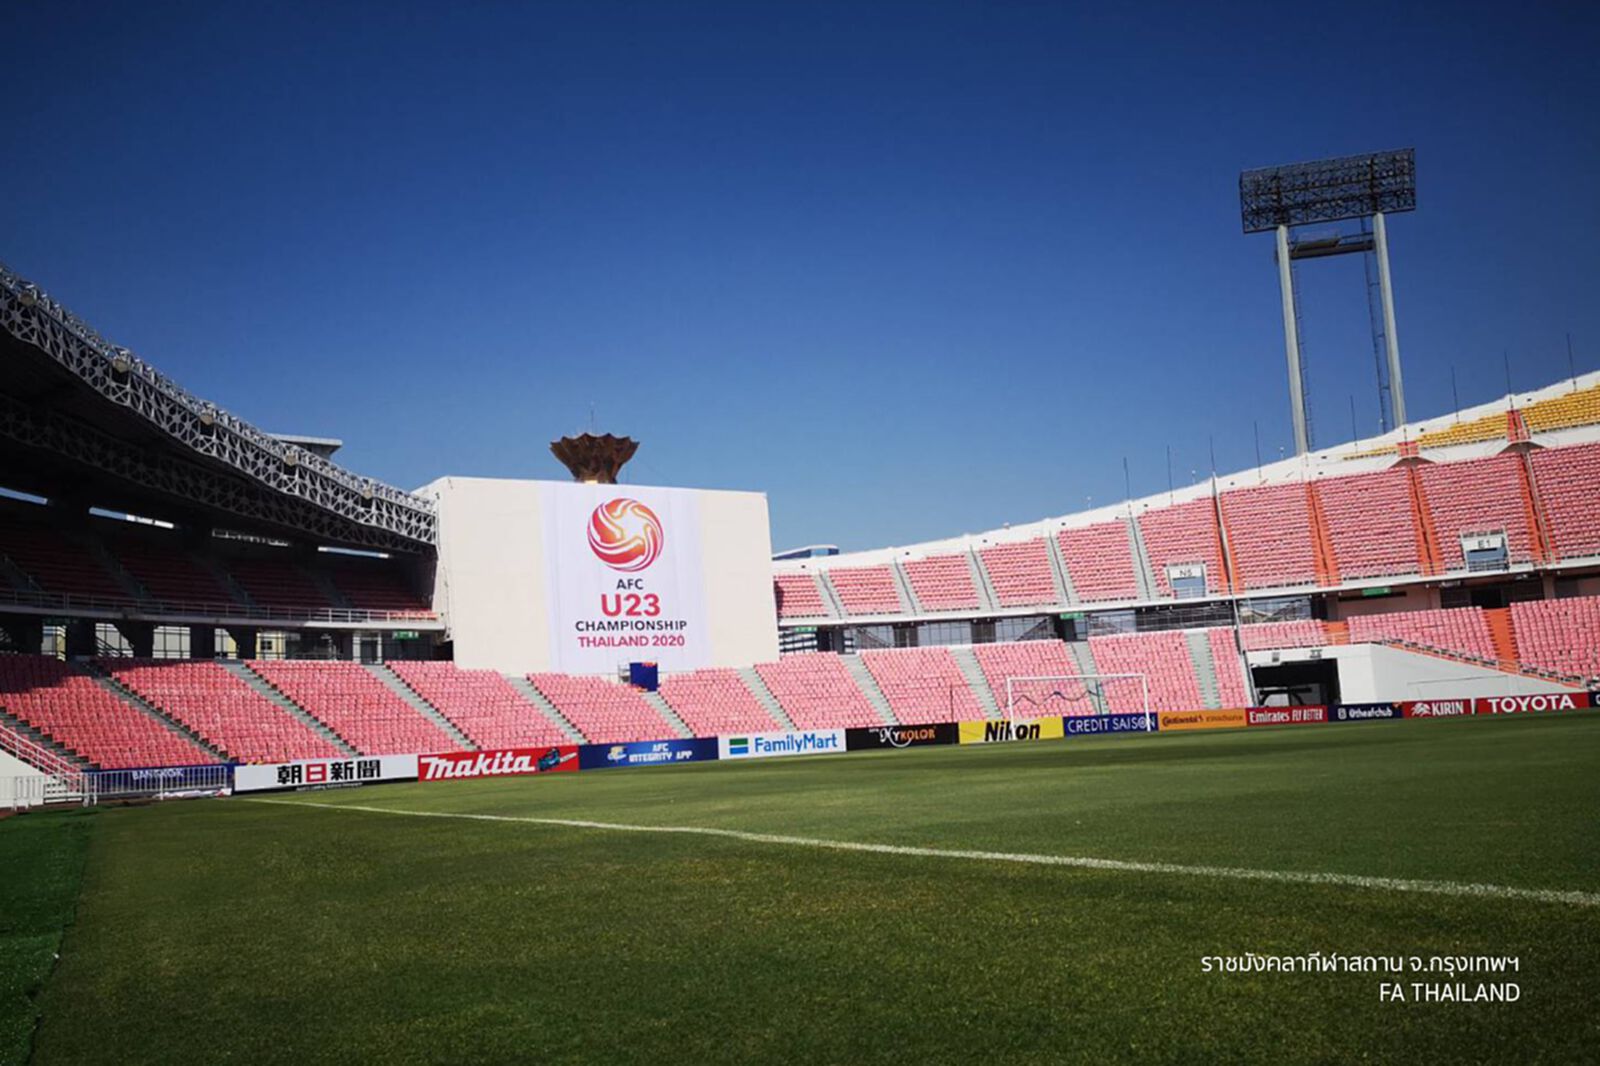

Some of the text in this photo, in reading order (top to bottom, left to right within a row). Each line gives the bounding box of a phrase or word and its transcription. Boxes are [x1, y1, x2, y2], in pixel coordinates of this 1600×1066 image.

[616, 578, 644, 590] AFC
[601, 593, 661, 617] U23
[575, 620, 687, 632] CHAMPIONSHIP
[577, 634, 685, 648] THAILAND 2020
[1432, 701, 1464, 716] KIRIN
[1487, 694, 1575, 713] TOYOTA
[1067, 716, 1156, 733] CREDIT SAISON
[1249, 710, 1290, 724] Emirates
[984, 721, 1040, 742] Nikon
[652, 743, 669, 752] AFC
[754, 733, 838, 752] FamilyMart
[628, 750, 693, 763] INTEGRITY APP
[277, 760, 381, 784] 朝日新聞
